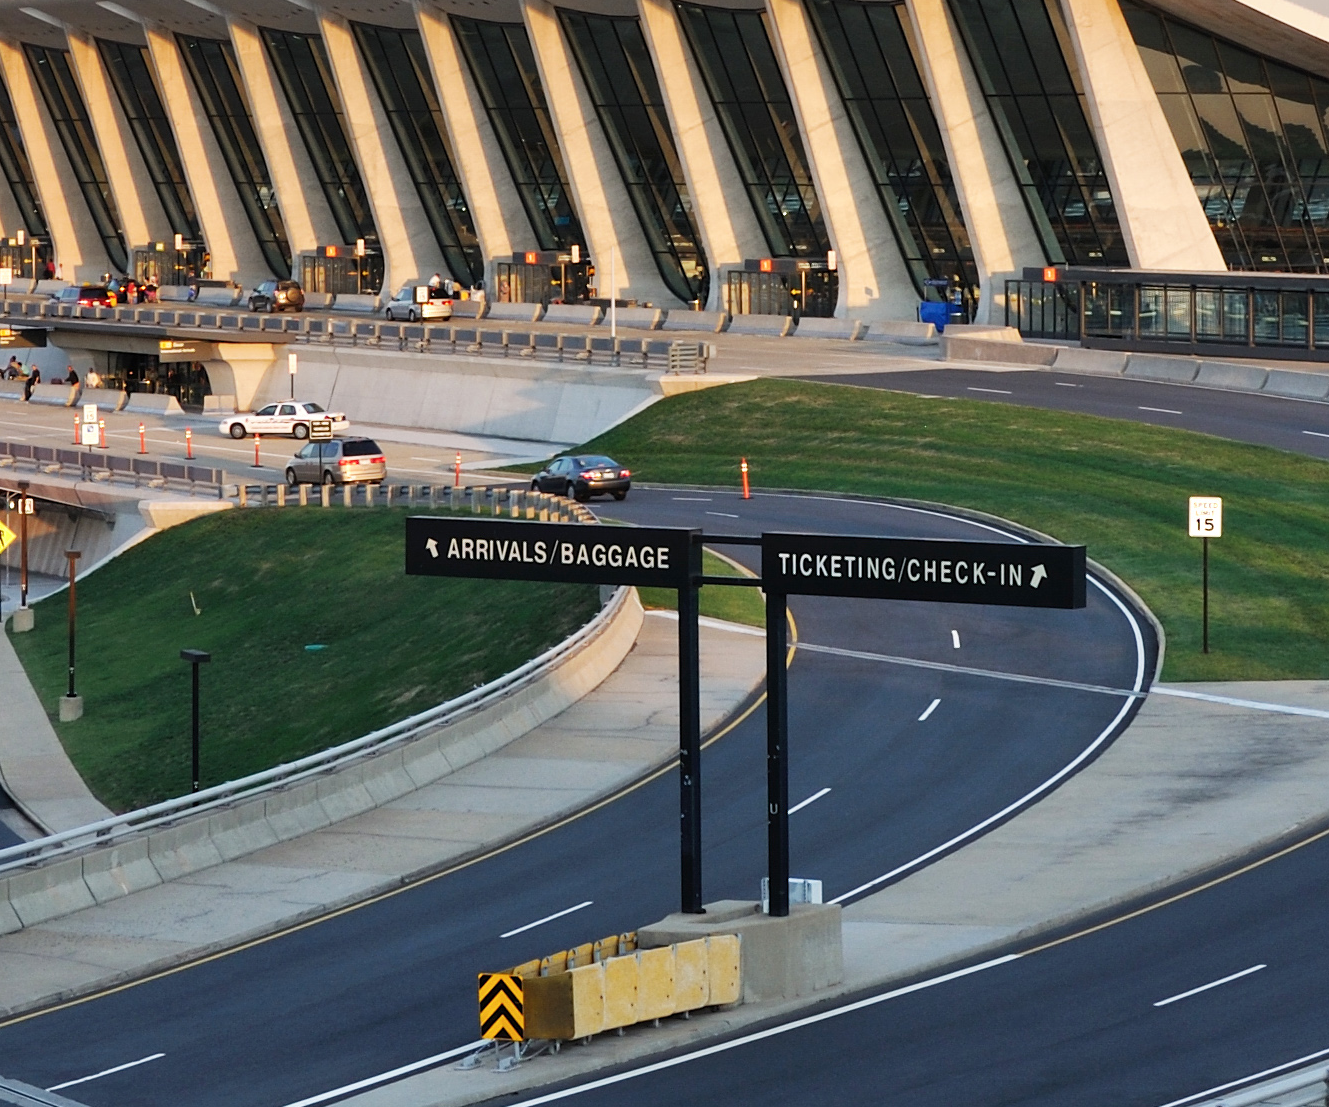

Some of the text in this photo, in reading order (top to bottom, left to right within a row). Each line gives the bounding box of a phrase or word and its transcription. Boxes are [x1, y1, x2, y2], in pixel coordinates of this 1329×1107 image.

[1196, 518, 1214, 532] 15
[447, 537, 670, 569] ARRIVALS/BAGGAGE
[778, 552, 1023, 587] TICKETING/CHECK-IN
